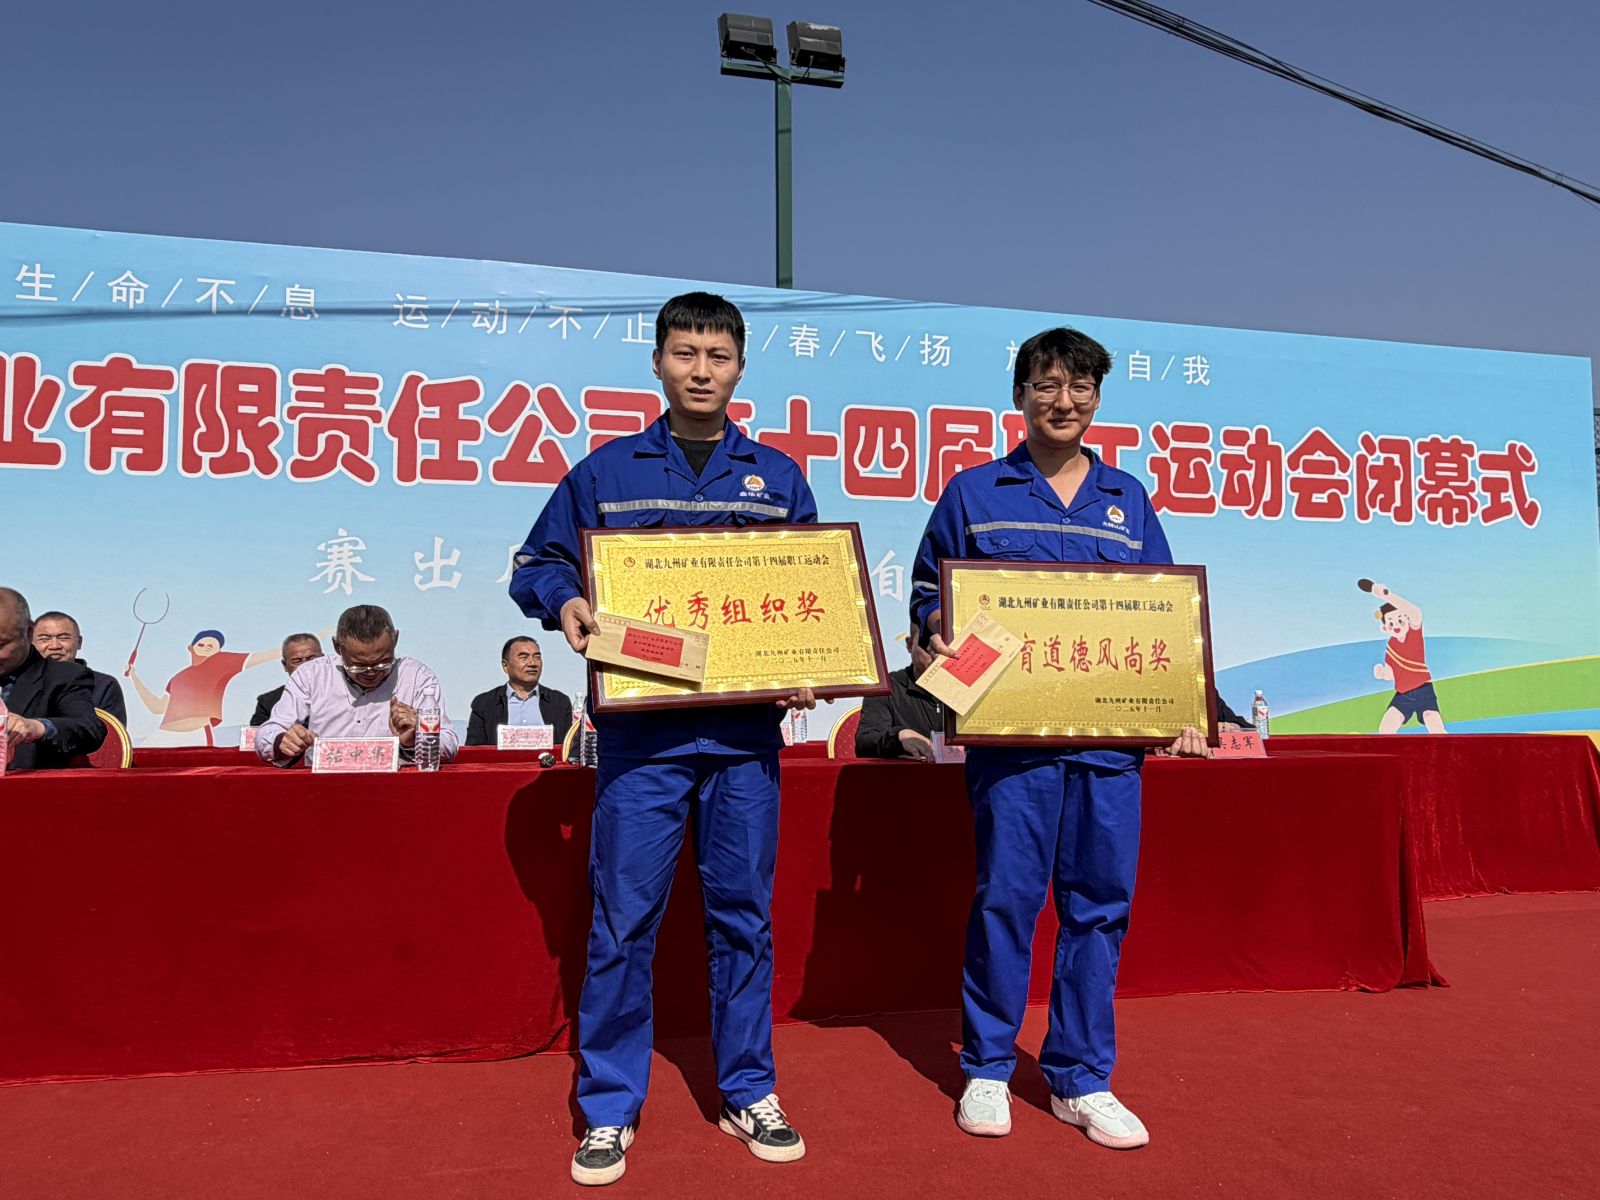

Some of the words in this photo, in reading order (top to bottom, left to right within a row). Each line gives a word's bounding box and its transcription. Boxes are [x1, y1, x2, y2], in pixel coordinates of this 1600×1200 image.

[645, 554, 830, 570] 湖北九州矿业有限责任公司第十四届职工运动会
[643, 590, 826, 631] 优秀组织奖
[998, 596, 1174, 613] 湖北九州矿业有限责任公司第十四届职工运动会
